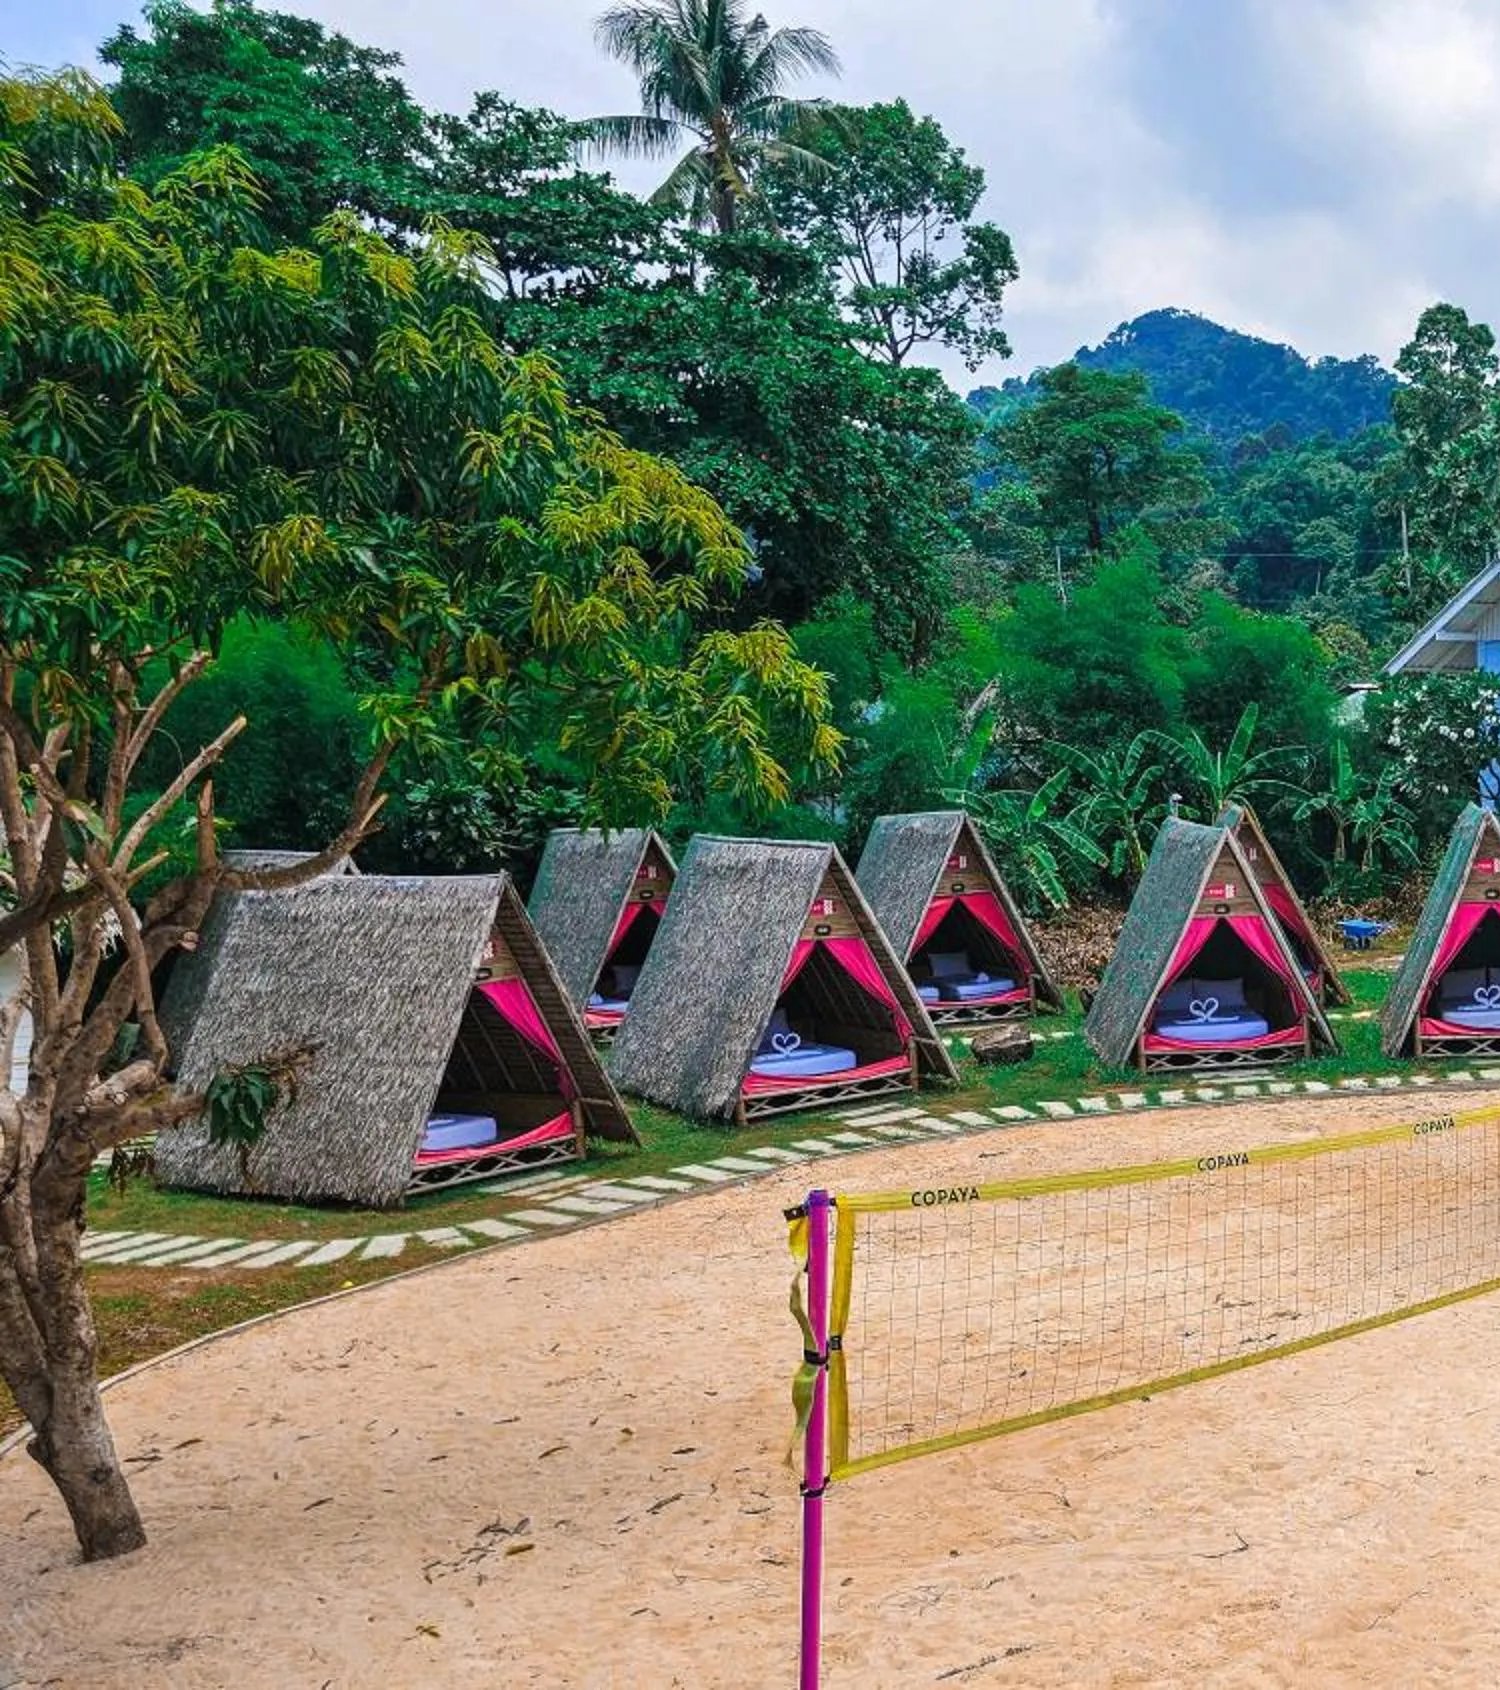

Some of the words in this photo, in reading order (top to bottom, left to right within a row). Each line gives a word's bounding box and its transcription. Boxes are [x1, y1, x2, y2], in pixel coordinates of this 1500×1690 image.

[1413, 1117, 1455, 1135] COPAYA
[1197, 1152, 1249, 1171] COPAYA
[911, 1186, 980, 1207] COPAYA
